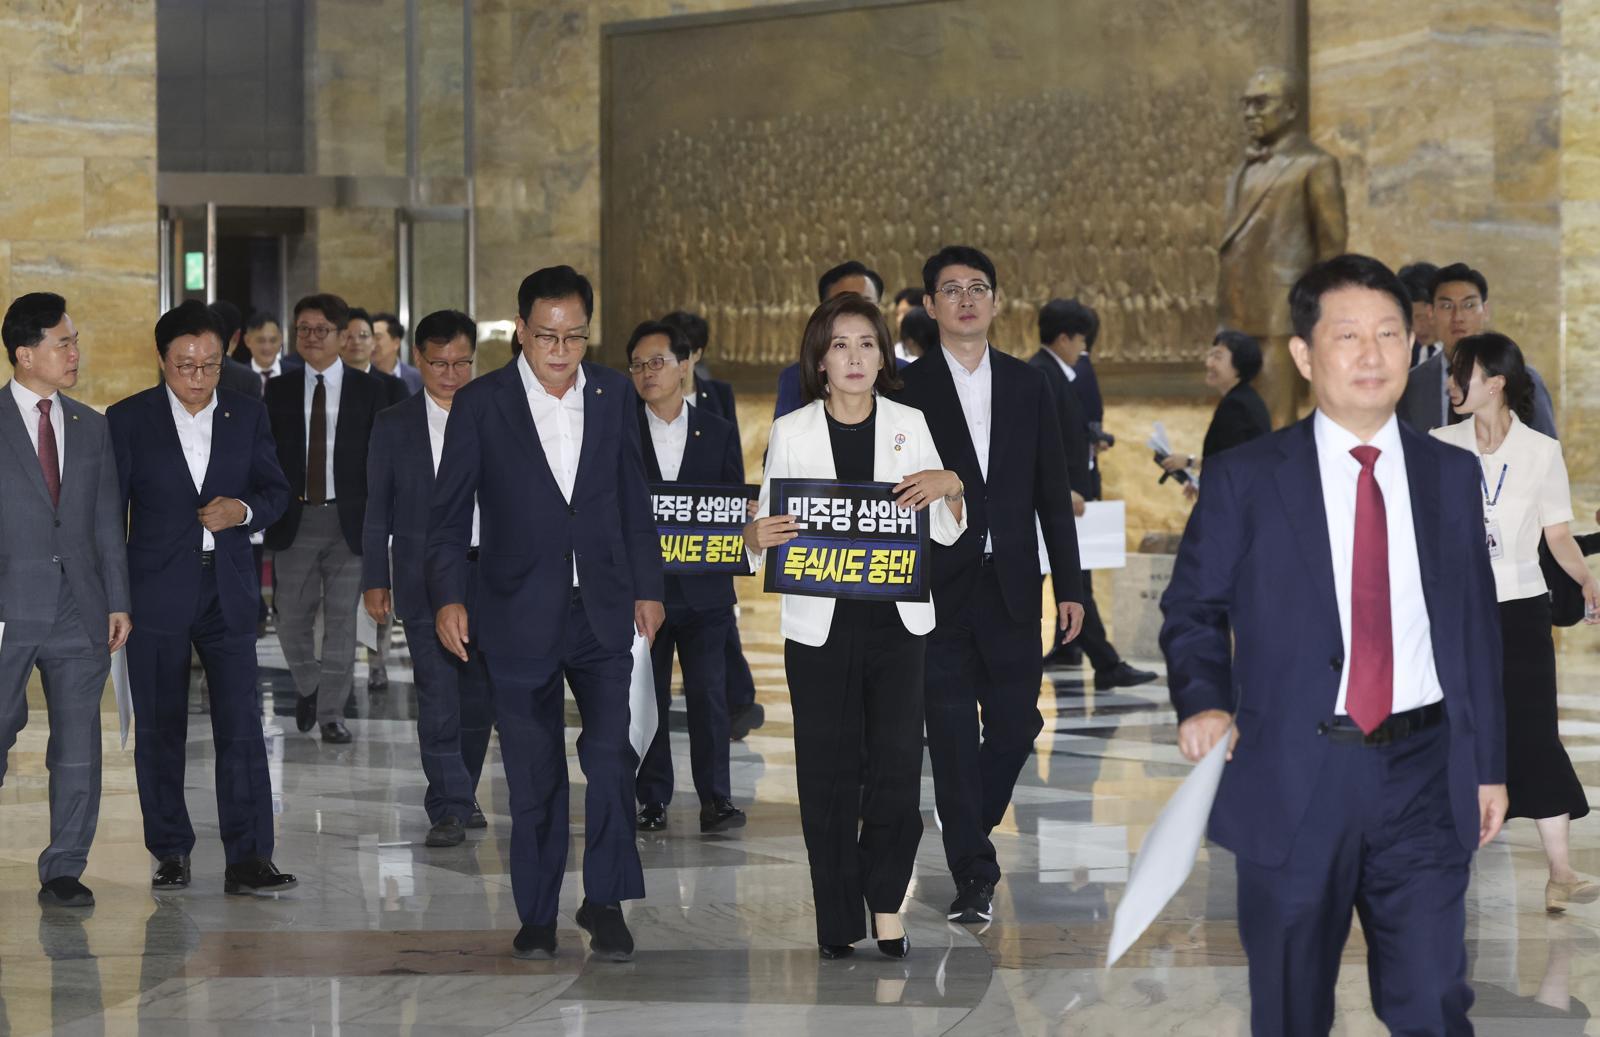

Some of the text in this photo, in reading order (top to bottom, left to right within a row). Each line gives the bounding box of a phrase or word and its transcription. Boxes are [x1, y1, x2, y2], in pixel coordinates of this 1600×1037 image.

[697, 496, 747, 523] 상임위
[787, 497, 917, 534] 민주당 상임위
[660, 535, 744, 563] 식시도 중단!
[784, 547, 917, 584] 독식시도 중단!
